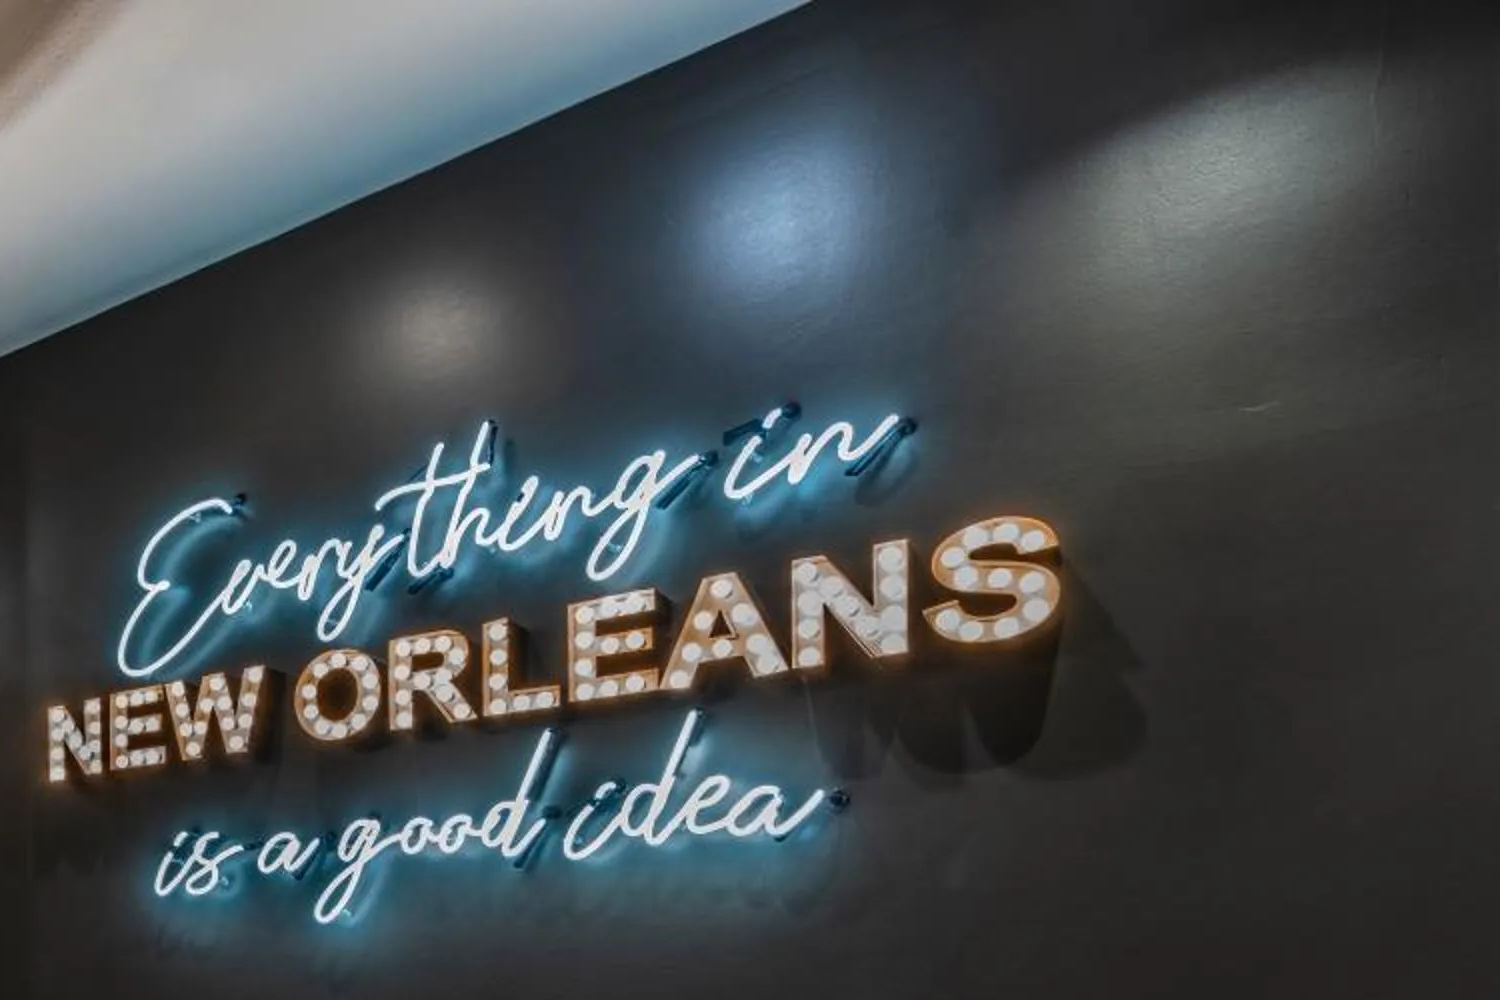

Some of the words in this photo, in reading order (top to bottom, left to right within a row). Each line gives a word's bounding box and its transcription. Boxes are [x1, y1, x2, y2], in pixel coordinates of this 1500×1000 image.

[46, 663, 268, 783] NEW
[294, 514, 1064, 744] ORLEANS
[117, 418, 698, 678] Everything
[724, 407, 899, 499] in
[153, 825, 244, 897] is
[257, 827, 319, 877] a
[314, 726, 553, 924] good
[563, 708, 824, 861] idea
